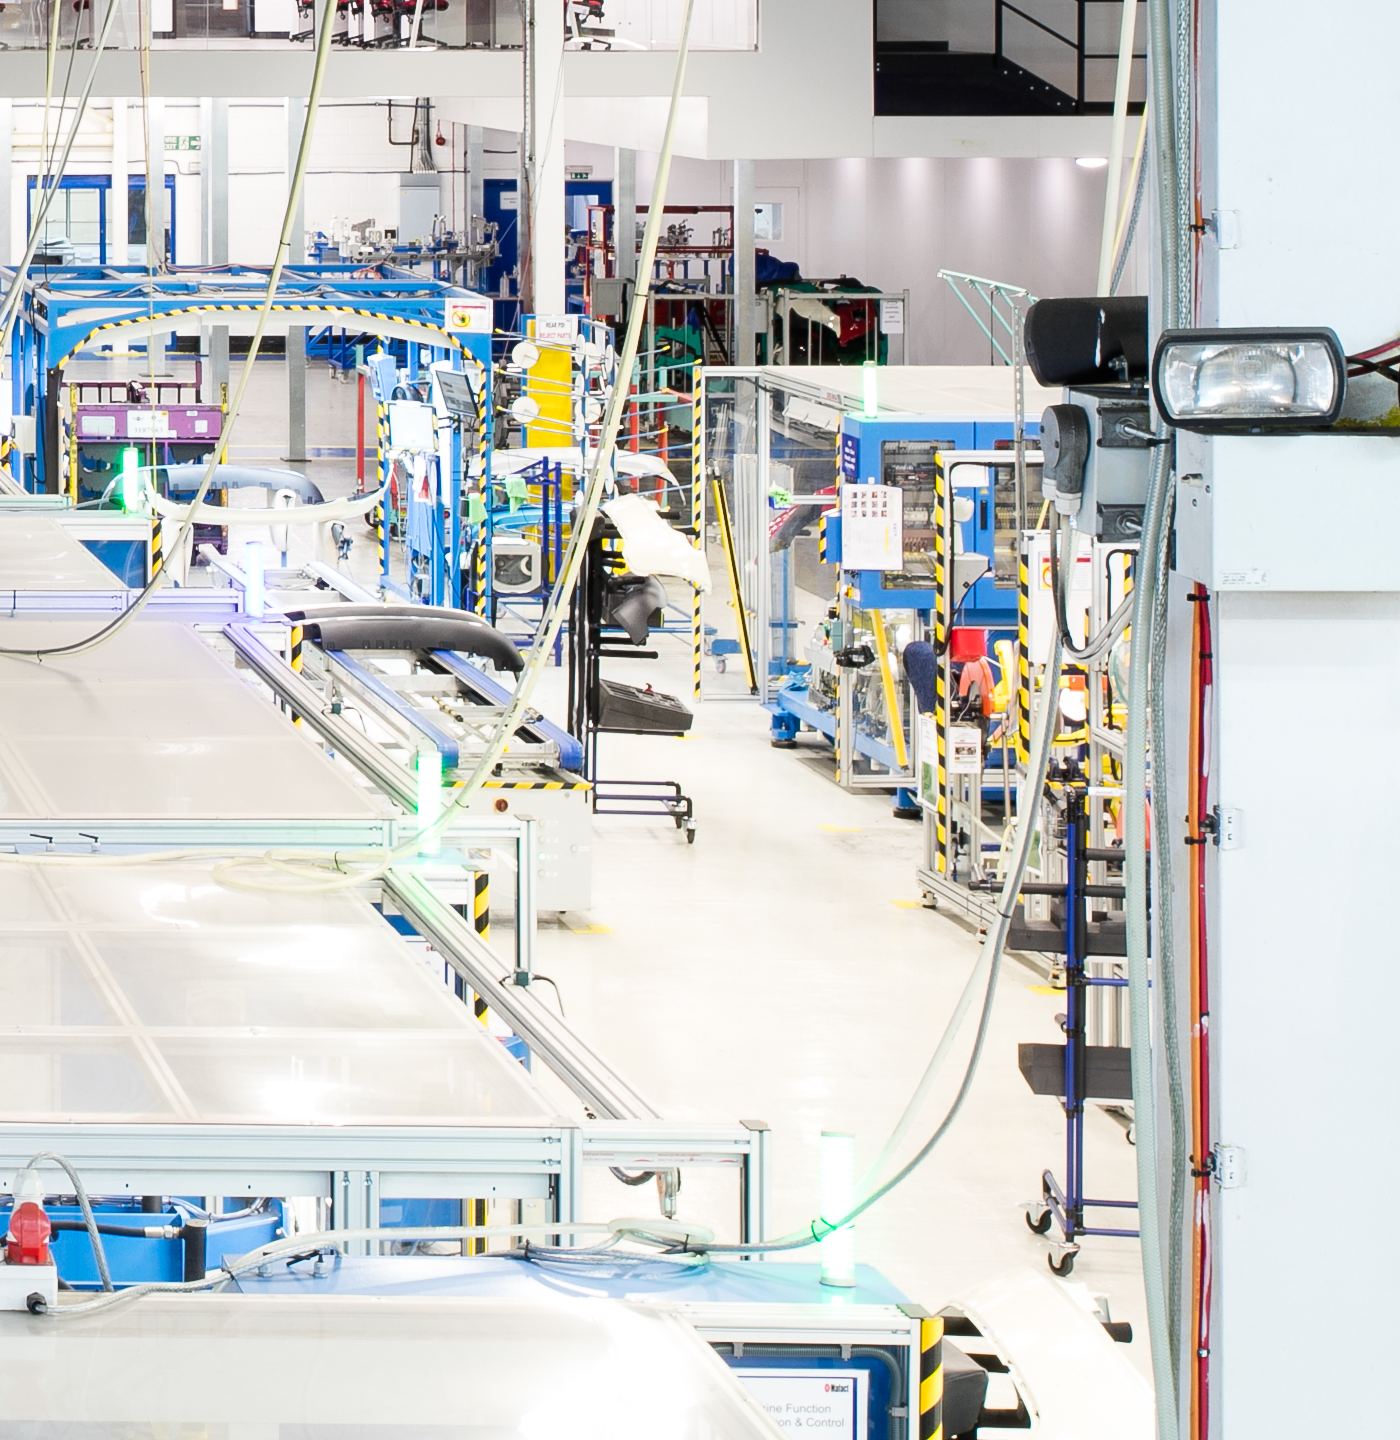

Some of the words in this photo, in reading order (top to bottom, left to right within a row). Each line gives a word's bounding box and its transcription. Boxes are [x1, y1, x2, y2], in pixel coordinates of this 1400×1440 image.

[786, 1403, 831, 1413] Function
[794, 1417, 802, 1427] &
[806, 1417, 845, 1427] Control
